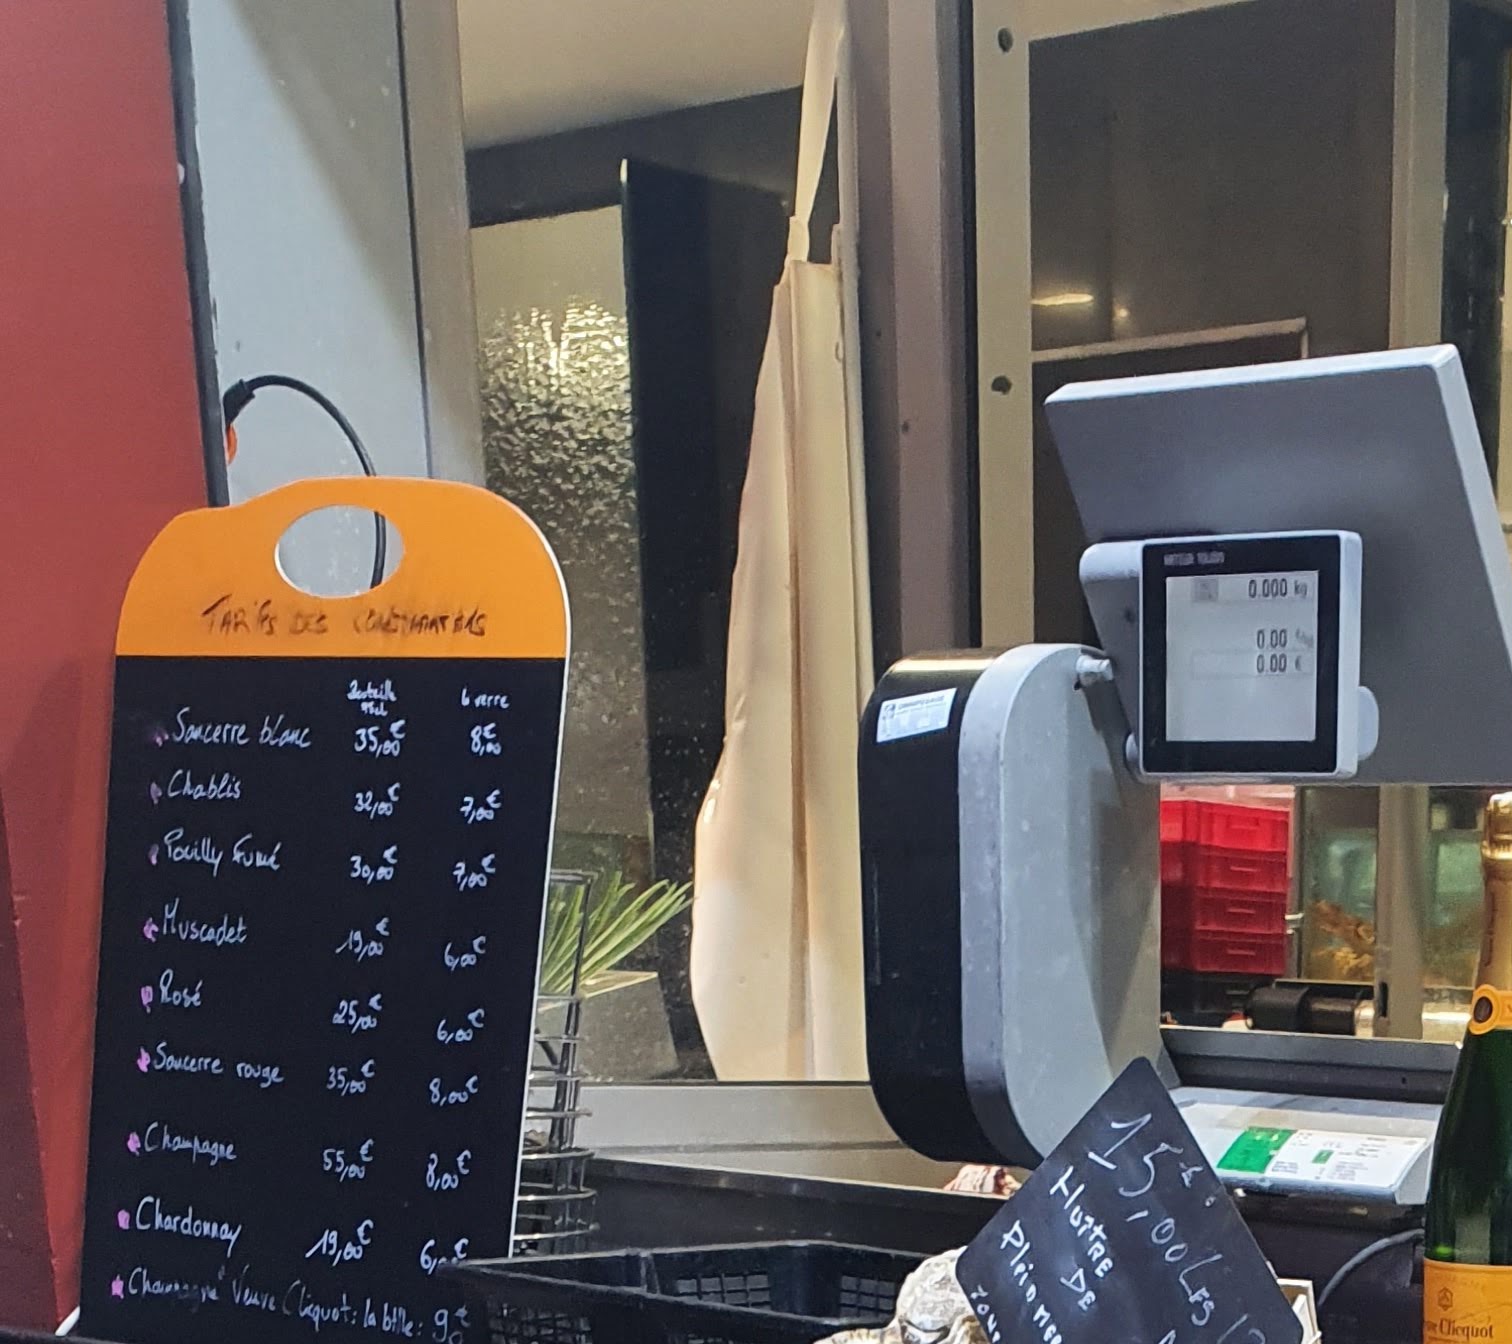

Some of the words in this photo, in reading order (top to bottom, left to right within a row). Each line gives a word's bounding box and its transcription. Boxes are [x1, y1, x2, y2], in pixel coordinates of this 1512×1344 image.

[171, 707, 251, 747] Sancerre
[166, 768, 243, 801] Chablis
[162, 898, 249, 945] Muscadet
[159, 968, 205, 1008] Rosé
[236, 1055, 285, 1085] rouge
[144, 1121, 239, 1168] Champagne
[135, 1195, 243, 1259] Chardonnay
[1438, 1316, 1496, 1344] Clicquot
